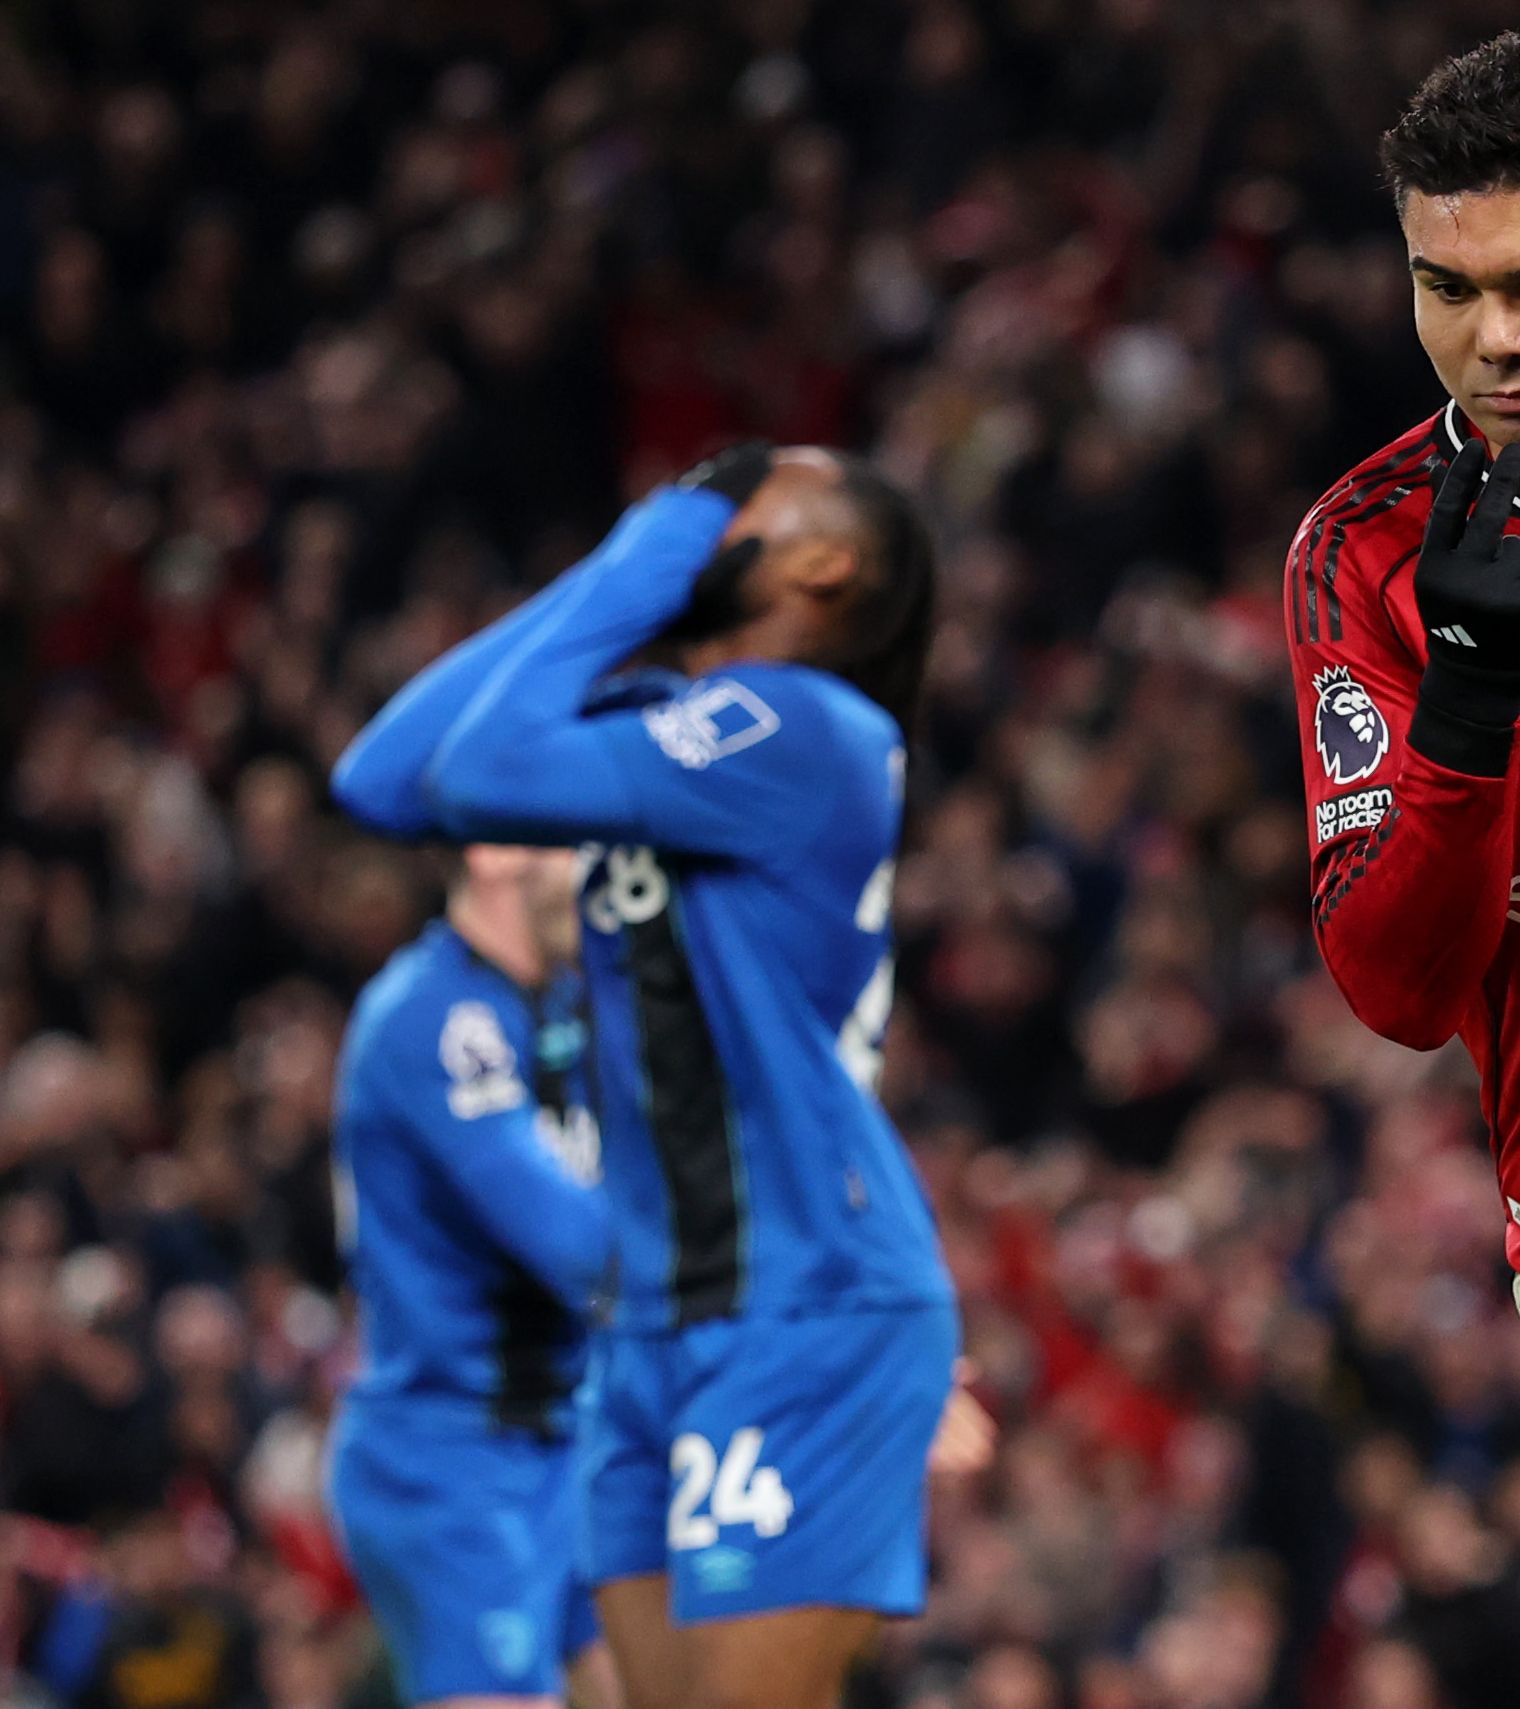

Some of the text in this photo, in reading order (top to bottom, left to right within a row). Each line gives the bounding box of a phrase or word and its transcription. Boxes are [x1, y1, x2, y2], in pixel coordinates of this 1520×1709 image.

[1316, 788, 1393, 823] No room
[1317, 820, 1337, 844] for
[667, 1426, 795, 1551] 24
